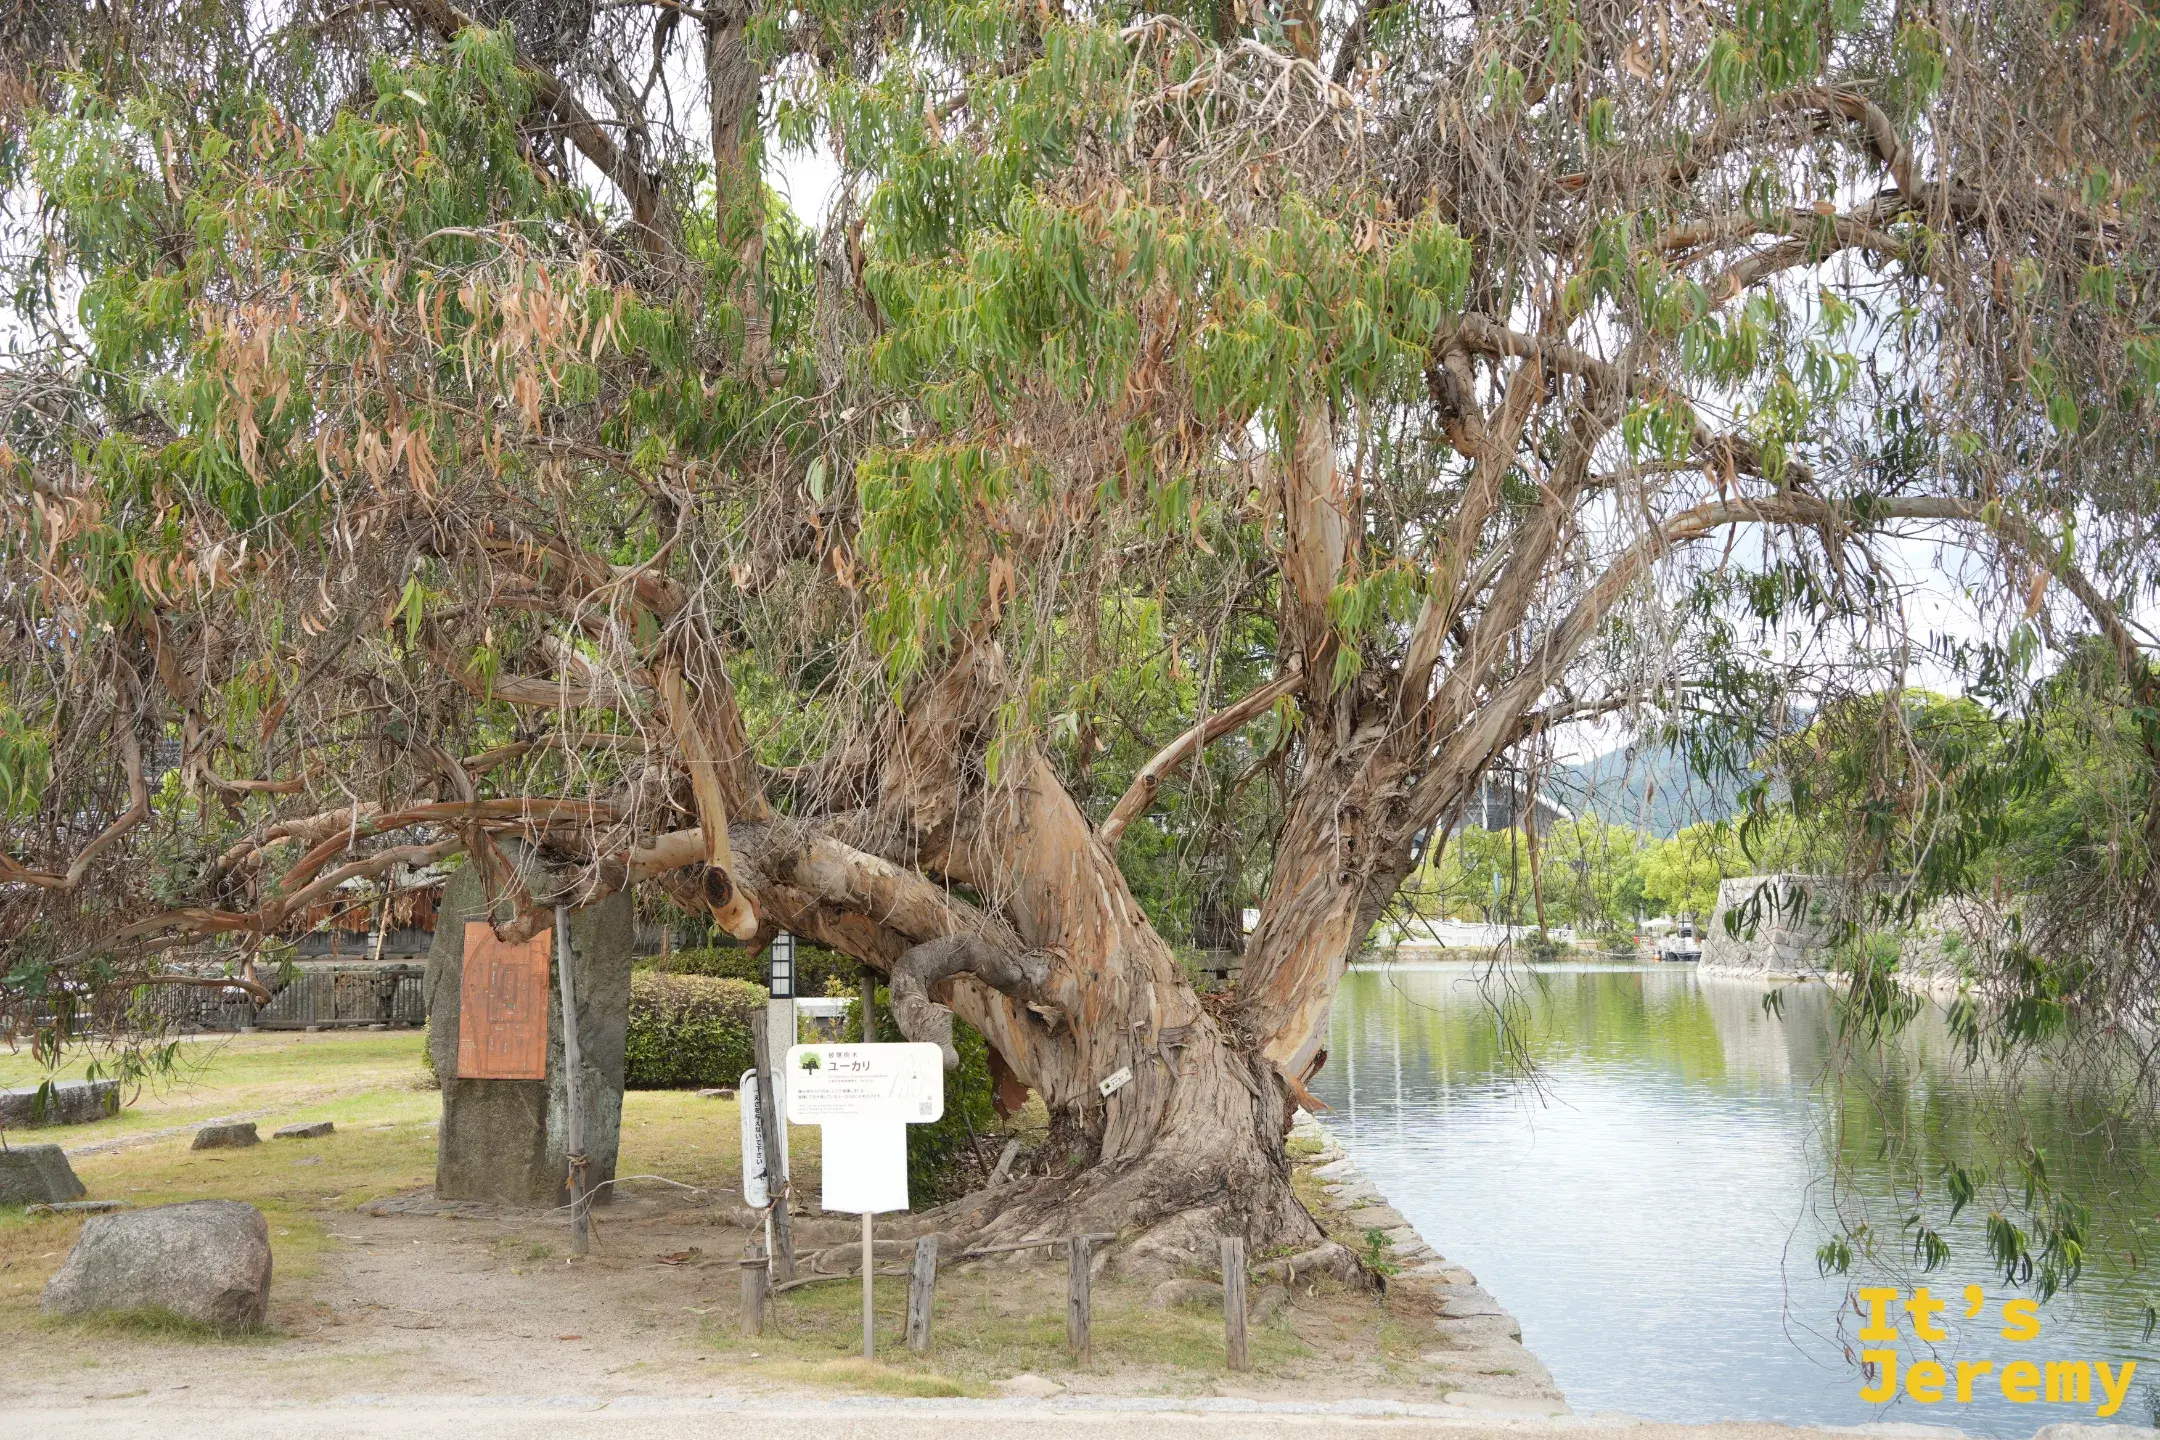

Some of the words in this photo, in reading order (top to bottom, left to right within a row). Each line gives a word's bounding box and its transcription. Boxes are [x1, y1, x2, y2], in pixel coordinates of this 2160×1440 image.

[828, 1060, 871, 1072] ユーカリ
[754, 1094, 763, 1165] えさを与えないで下さい
